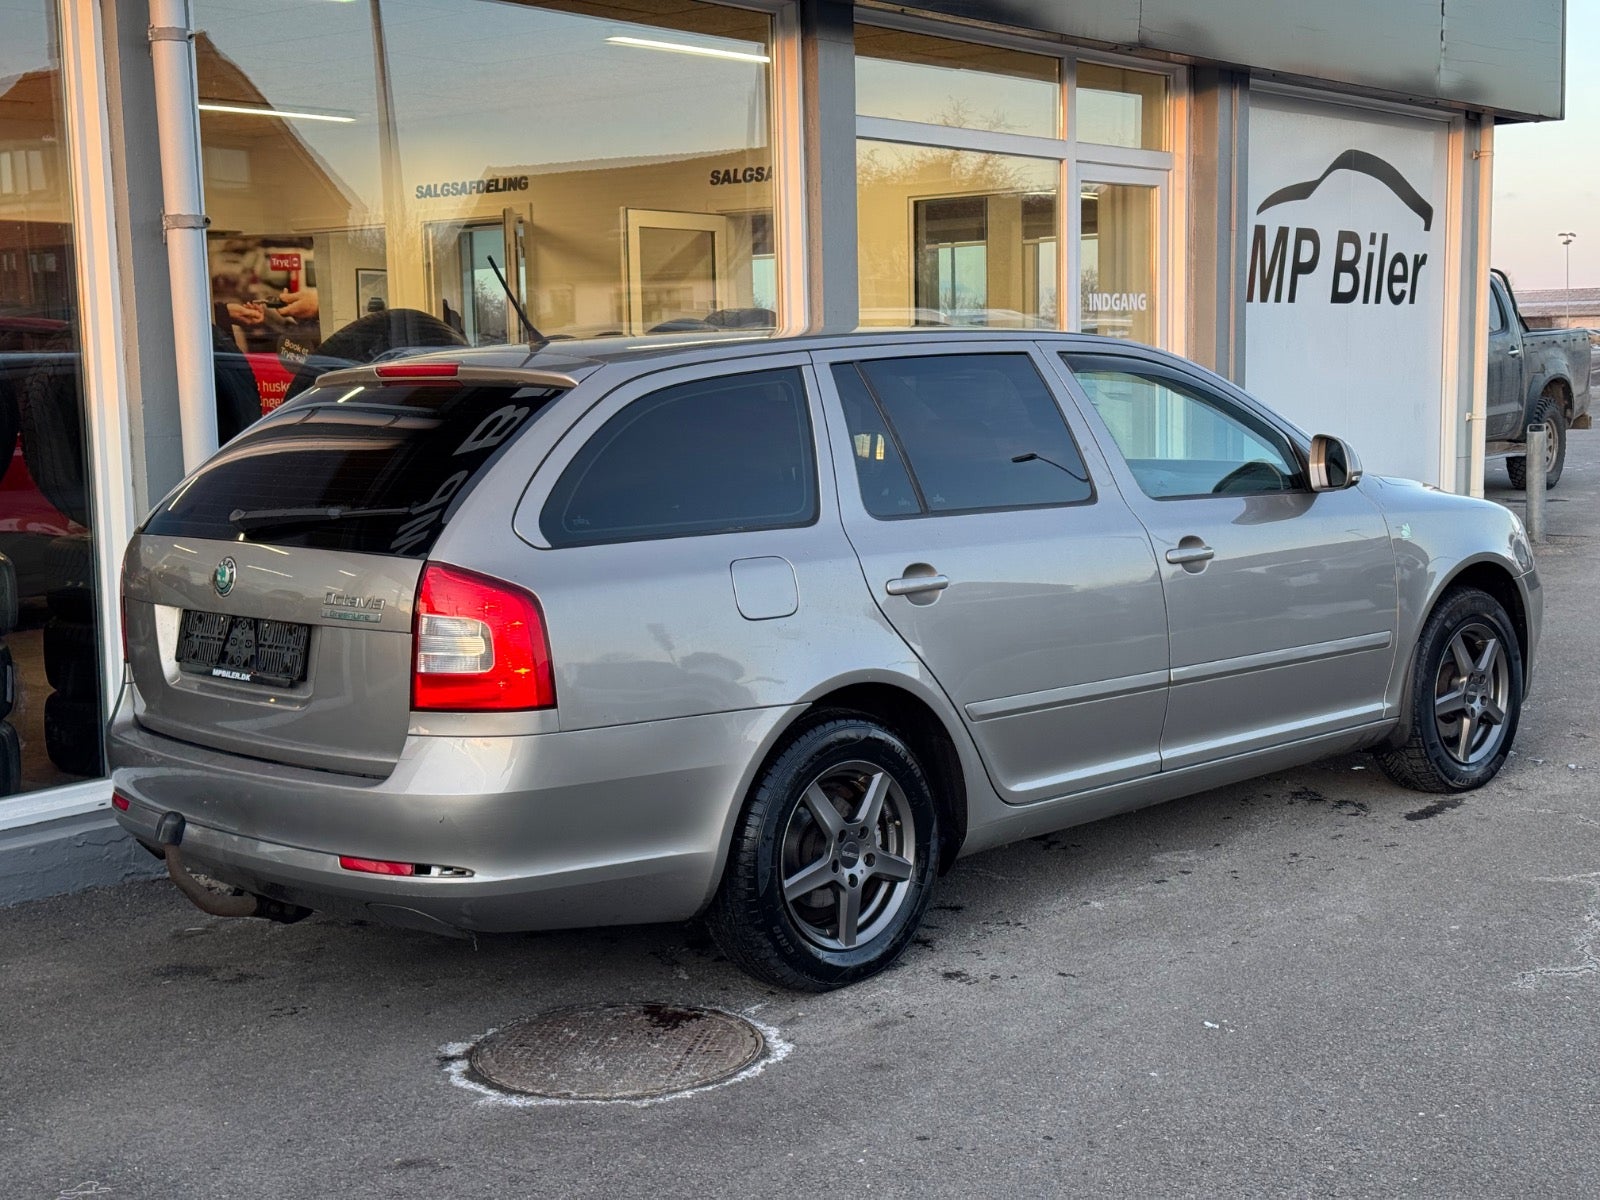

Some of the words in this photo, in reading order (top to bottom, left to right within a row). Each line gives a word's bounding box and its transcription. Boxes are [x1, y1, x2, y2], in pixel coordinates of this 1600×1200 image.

[415, 175, 529, 199] SALGSAFDELING
[271, 257, 289, 268] Tryg
[1246, 224, 1321, 304] MP
[1330, 230, 1428, 306] Biler
[1088, 292, 1147, 312] INDGANG
